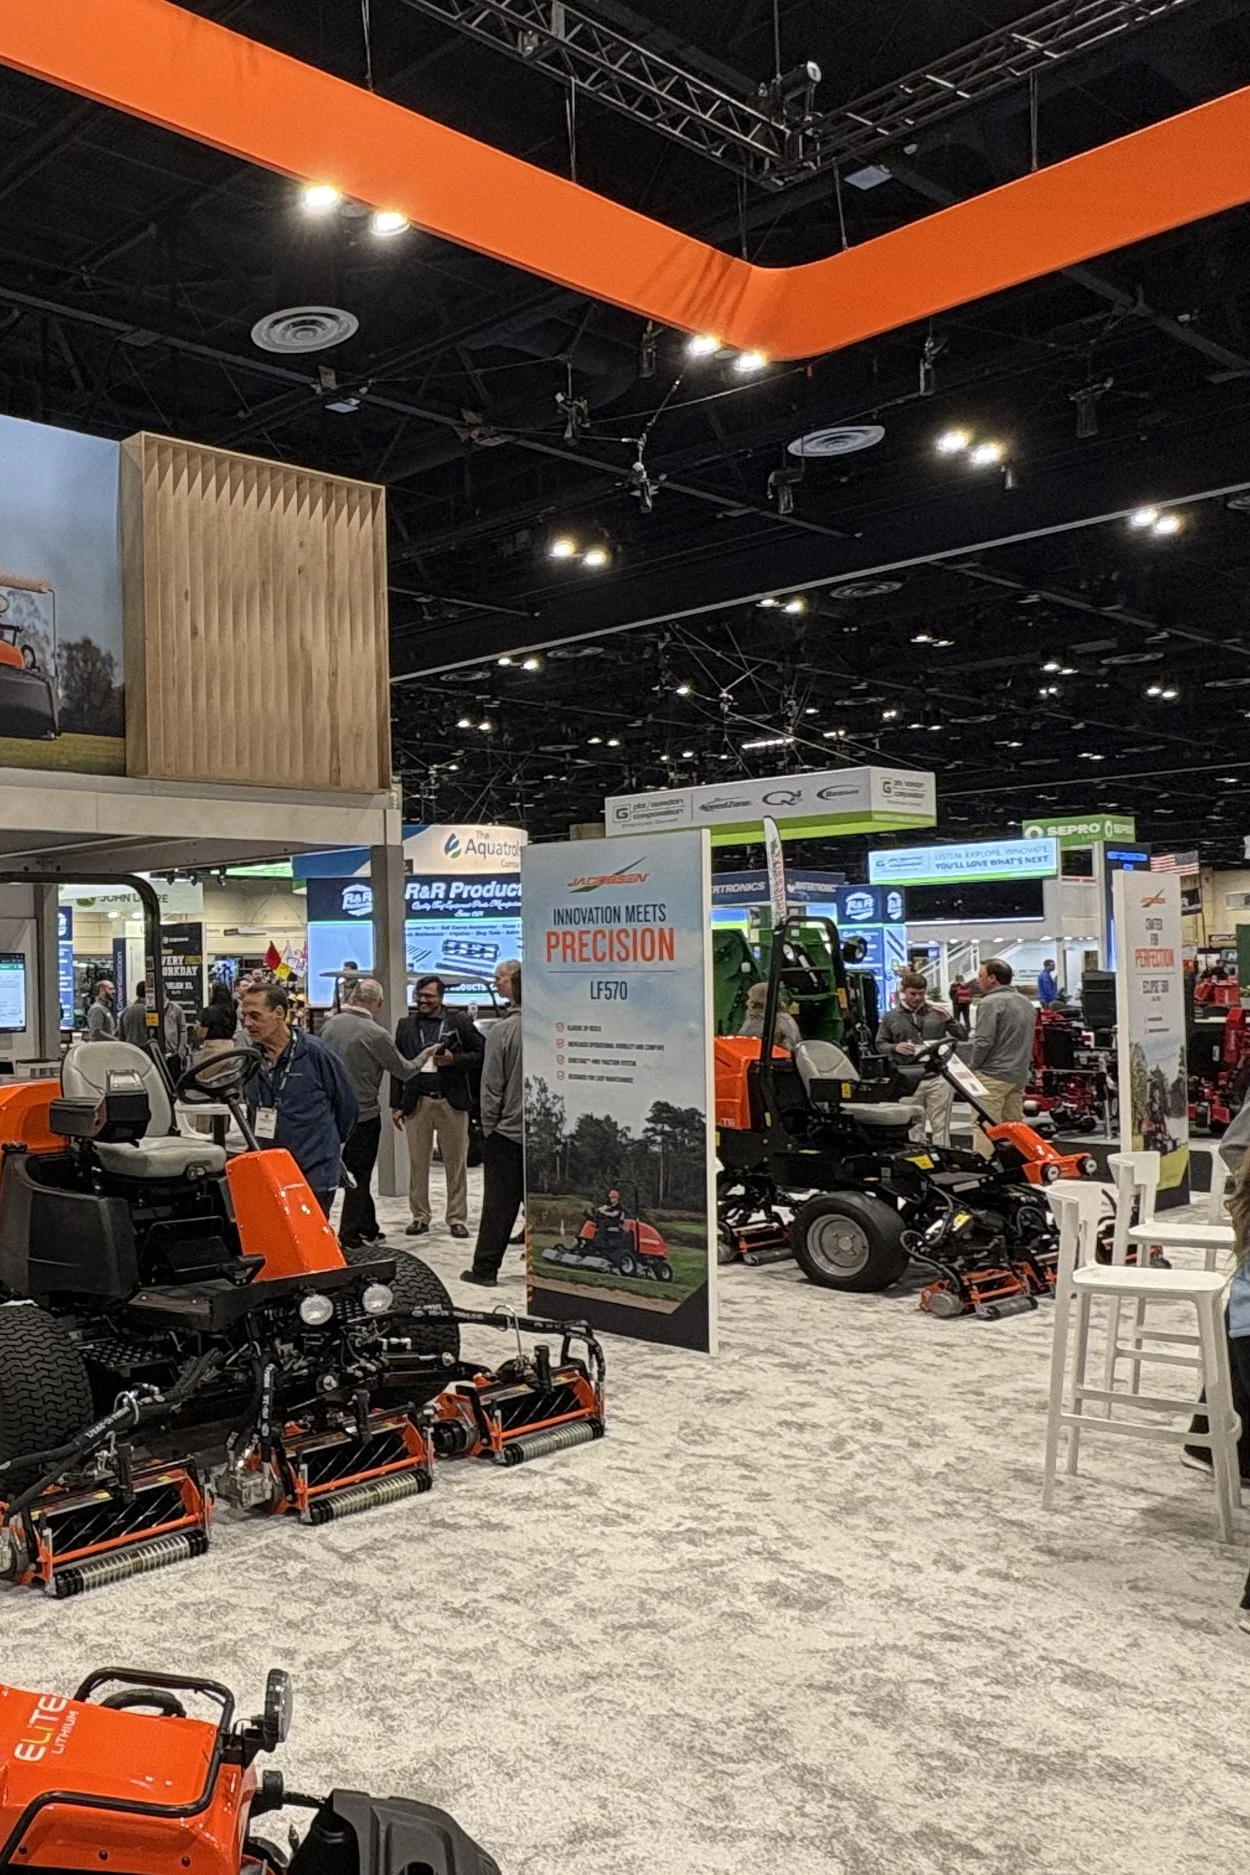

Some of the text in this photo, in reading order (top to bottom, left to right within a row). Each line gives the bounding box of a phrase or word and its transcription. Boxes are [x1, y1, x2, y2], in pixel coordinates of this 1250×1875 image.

[476, 831, 490, 840] The
[1047, 823, 1101, 836] SEPRO
[935, 855, 1049, 870] YOU'LL LOVE WHAT'S NEXT
[568, 873, 649, 888] JACOBSEN
[405, 882, 447, 899] R&R
[849, 899, 874, 910] R&R
[553, 903, 666, 926] INNOVATION MEETS
[546, 928, 675, 963] PRECISION
[590, 981, 628, 1000] LF570
[50, 1709, 80, 1755] LITHIUM
